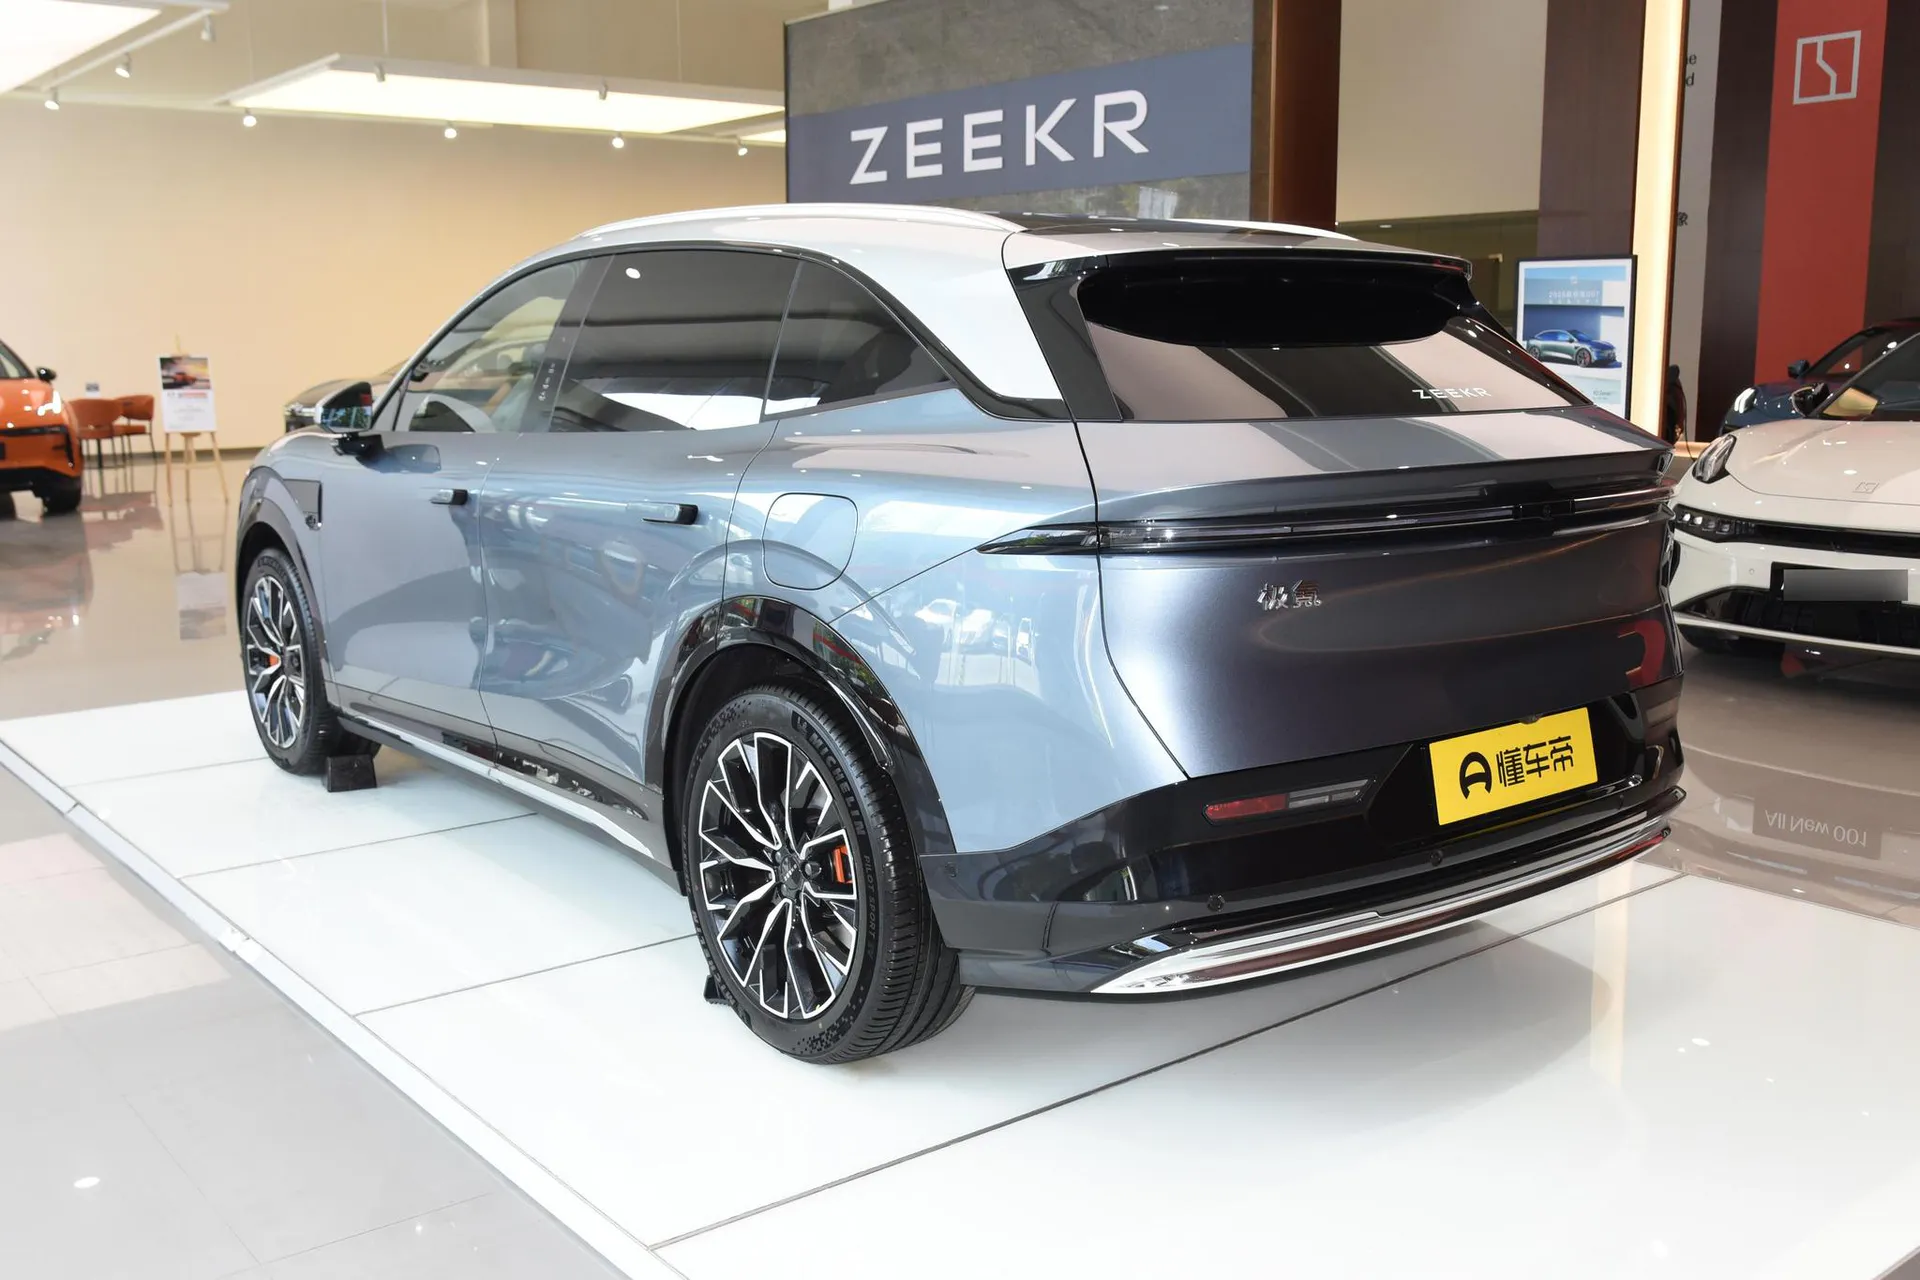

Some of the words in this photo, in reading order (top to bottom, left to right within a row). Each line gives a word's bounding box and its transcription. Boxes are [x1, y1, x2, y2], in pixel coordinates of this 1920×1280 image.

[850, 90, 1149, 184] ZEEKR
[1412, 387, 1492, 400] ZEEKR
[808, 731, 866, 836] MICHELIN
[1496, 735, 1574, 788] 懂车帝
[863, 854, 875, 893] PILOT
[868, 898, 877, 940] SPORT
